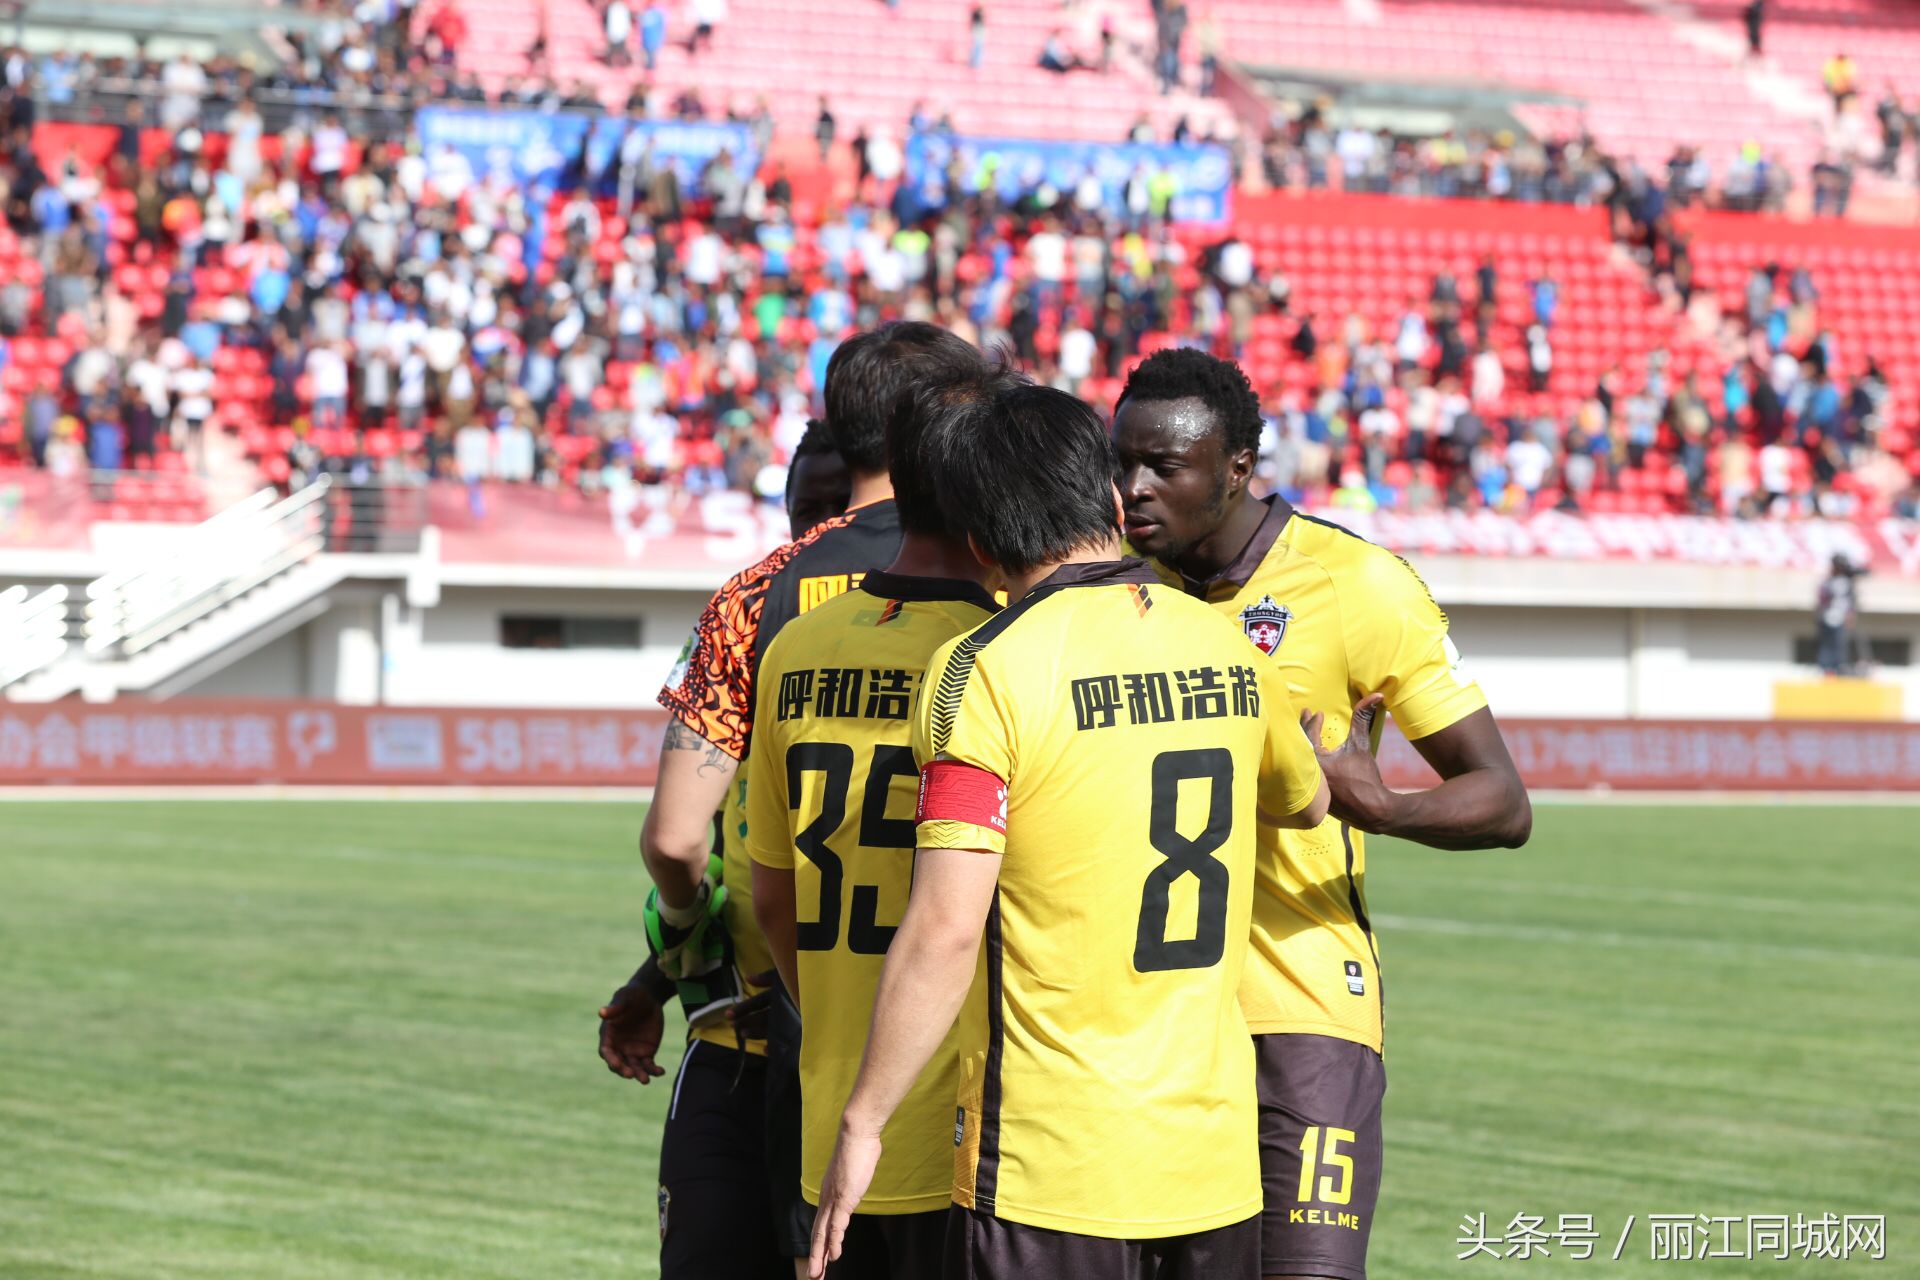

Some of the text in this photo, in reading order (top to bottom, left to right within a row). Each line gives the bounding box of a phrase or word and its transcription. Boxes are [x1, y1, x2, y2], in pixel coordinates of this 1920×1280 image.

[778, 668, 924, 722] 呼和浩
[1071, 665, 1260, 731] 呼和浩特
[786, 742, 920, 955] 35
[1133, 747, 1234, 973] 8
[1297, 1126, 1355, 1205] 15
[1289, 1209, 1359, 1230] KELME
